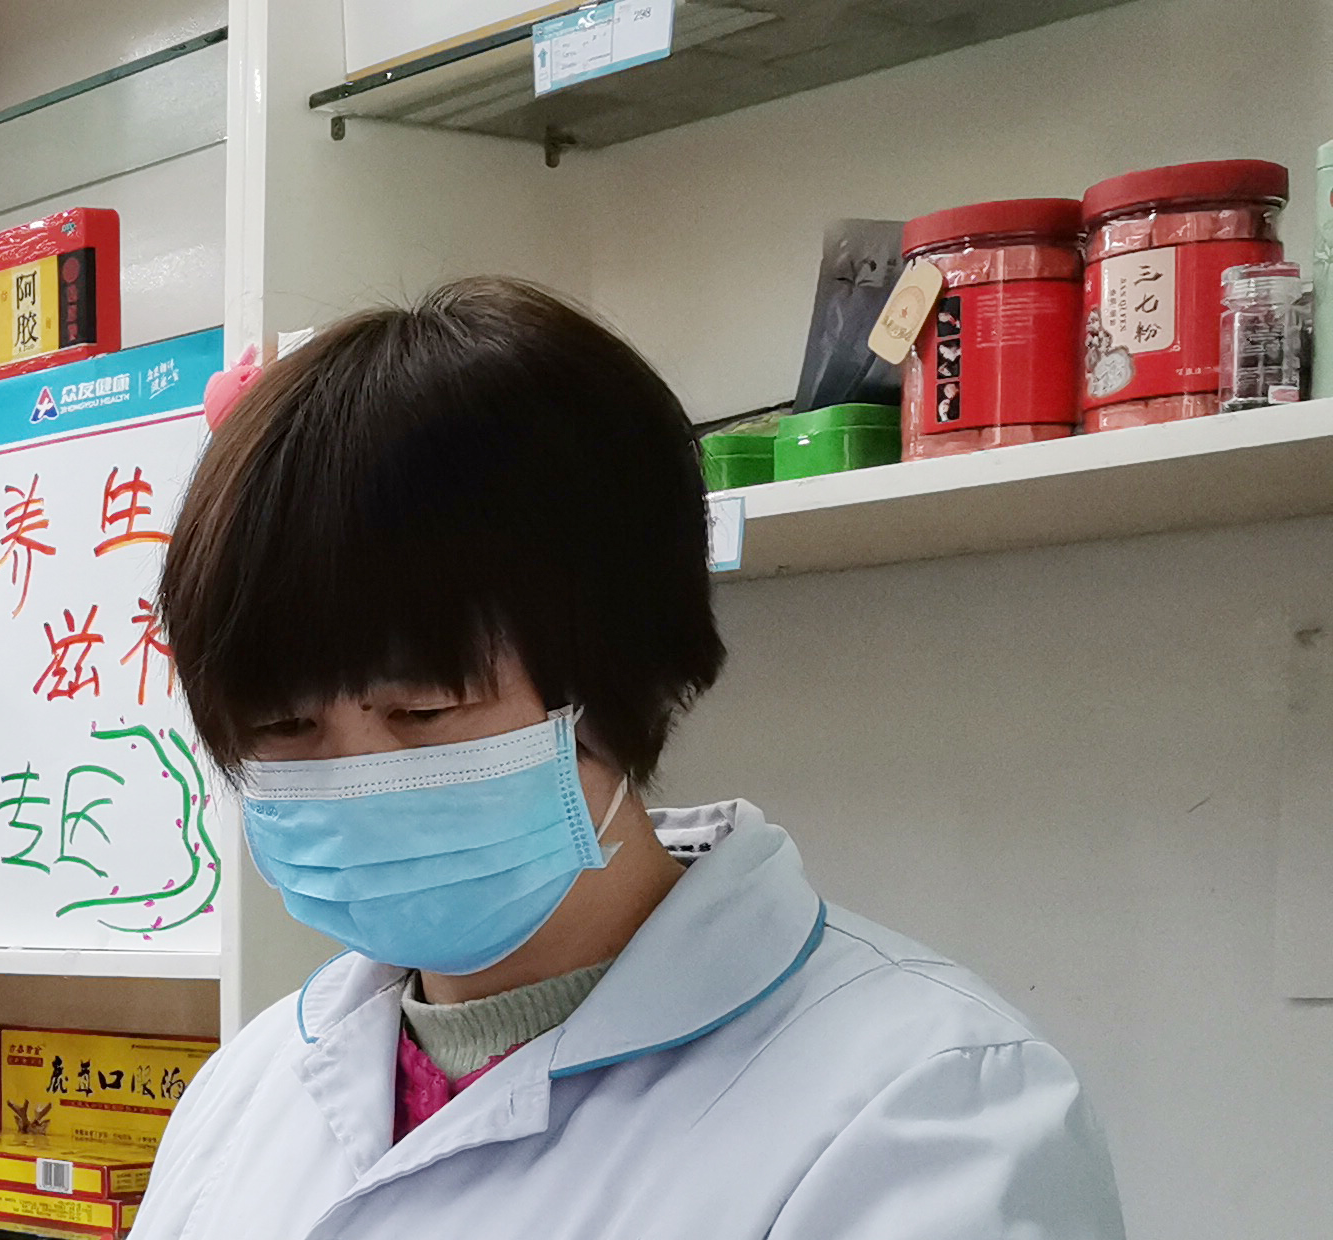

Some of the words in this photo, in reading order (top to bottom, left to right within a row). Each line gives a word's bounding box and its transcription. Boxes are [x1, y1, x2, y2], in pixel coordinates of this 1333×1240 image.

[16, 270, 39, 345] 阿胶
[1133, 263, 1163, 345] 三七粉
[59, 373, 131, 404] 众友健康
